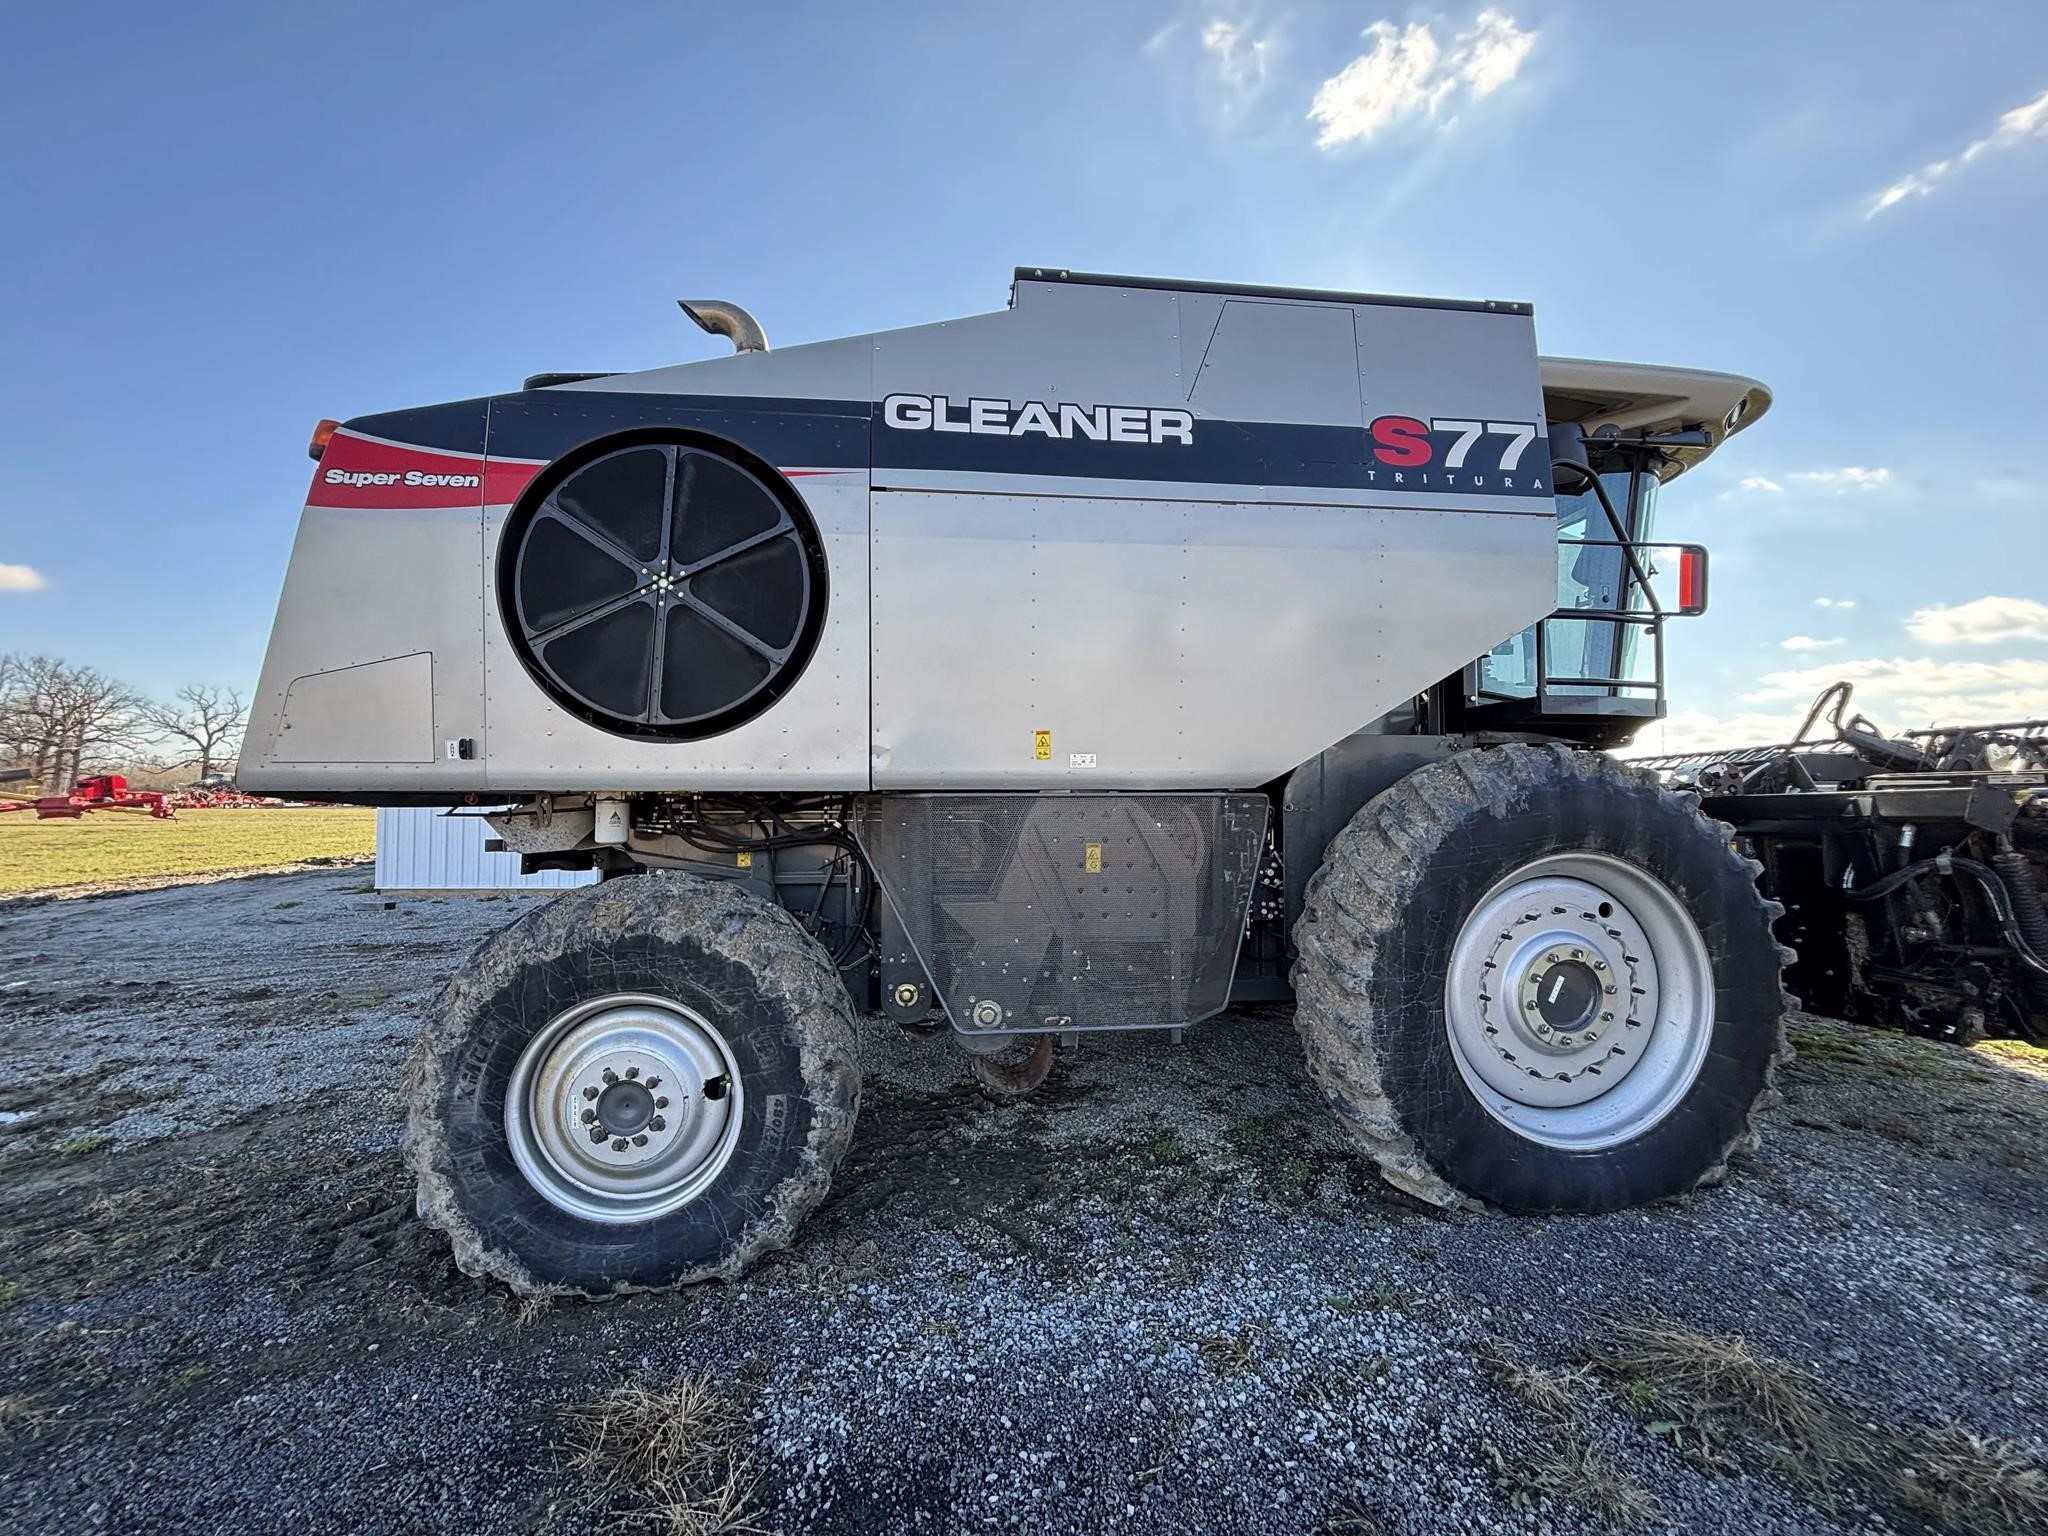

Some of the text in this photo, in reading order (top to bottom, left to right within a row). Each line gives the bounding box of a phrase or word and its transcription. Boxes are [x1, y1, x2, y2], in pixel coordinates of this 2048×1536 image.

[884, 394, 1194, 445] GLEANER
[1371, 416, 1537, 471] S77
[325, 468, 480, 488] Super Seven
[1367, 470, 1542, 489] TRITURA
